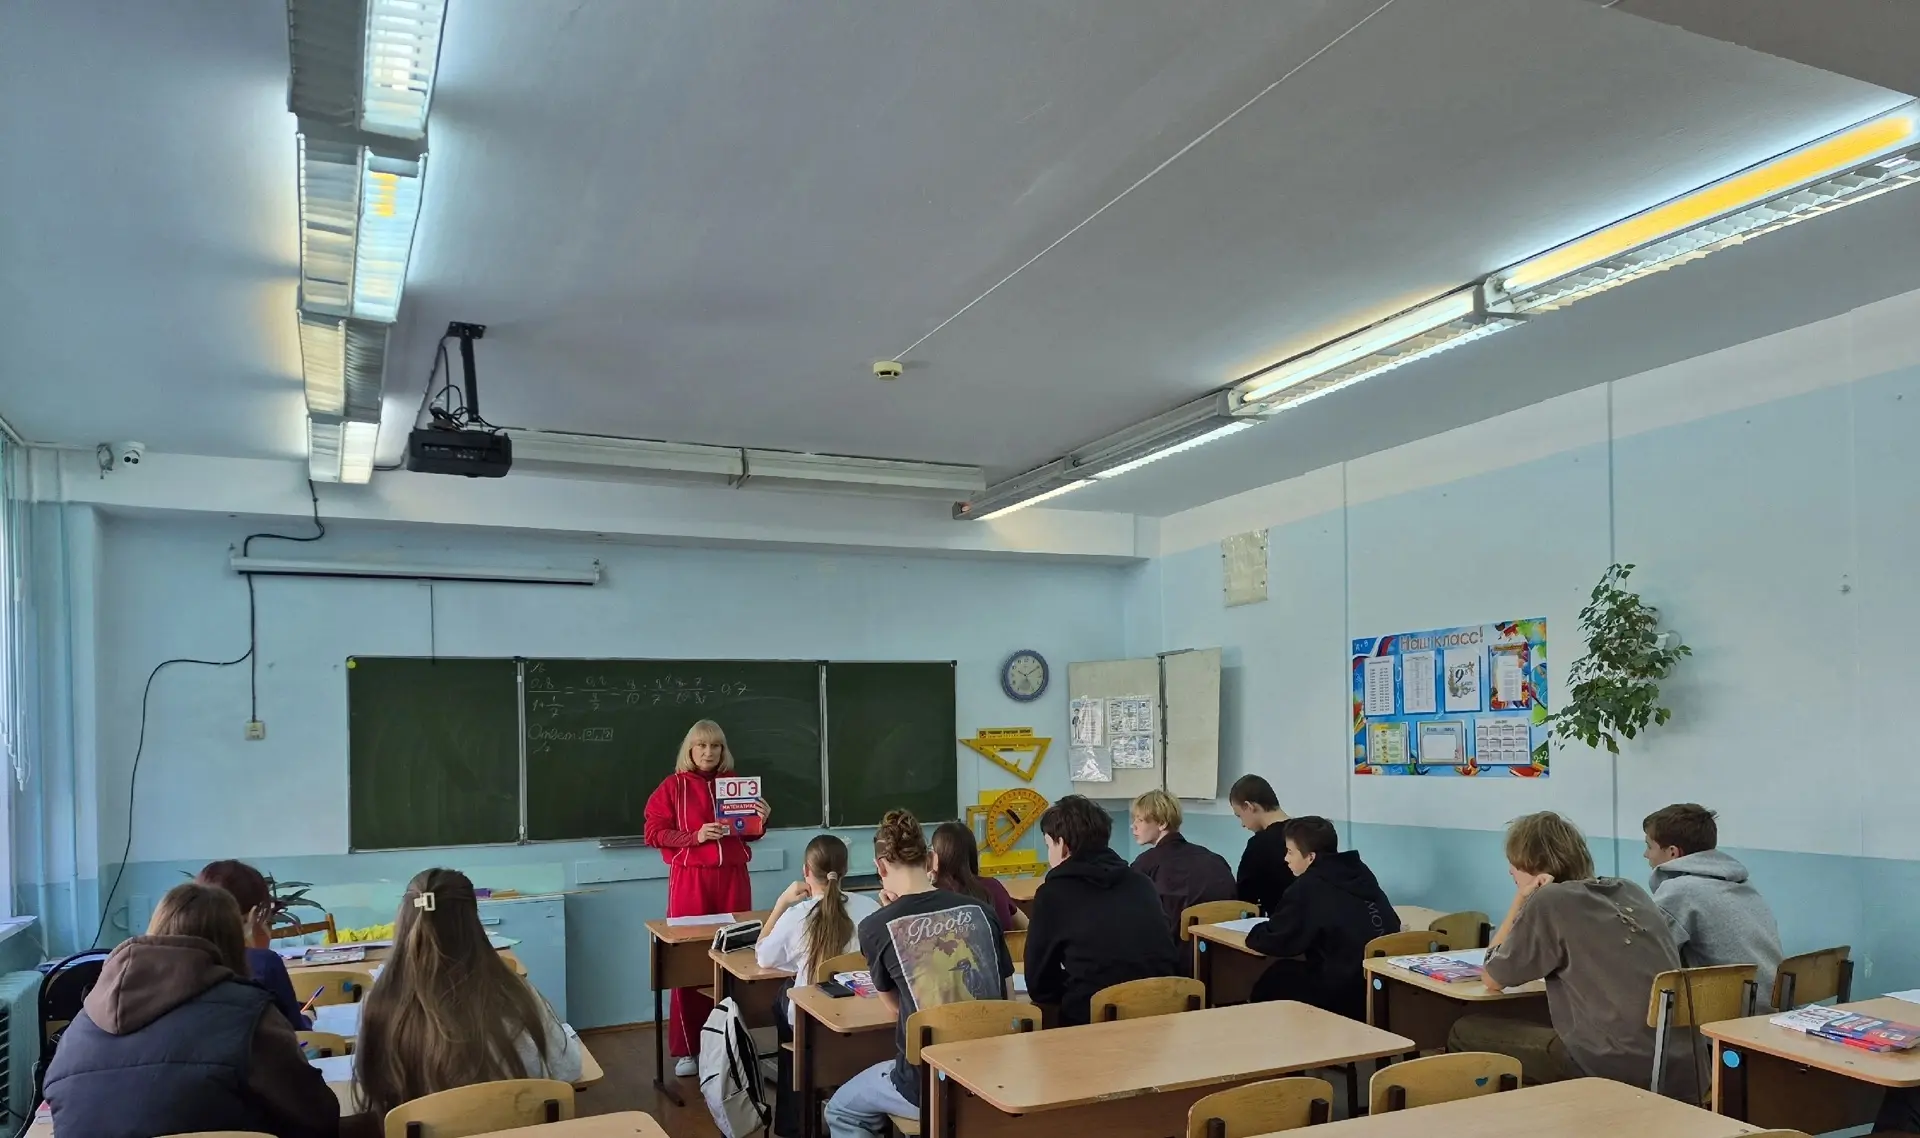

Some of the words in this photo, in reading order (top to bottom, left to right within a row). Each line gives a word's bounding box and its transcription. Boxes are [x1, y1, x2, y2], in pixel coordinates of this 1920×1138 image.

[1400, 635, 1430, 651] Наш
[1434, 626, 1484, 648] класс!
[1455, 669, 1464, 684] 9
[726, 780, 758, 797] ОГЭ
[908, 911, 972, 945] Roots
[954, 922, 976, 936] 1973
